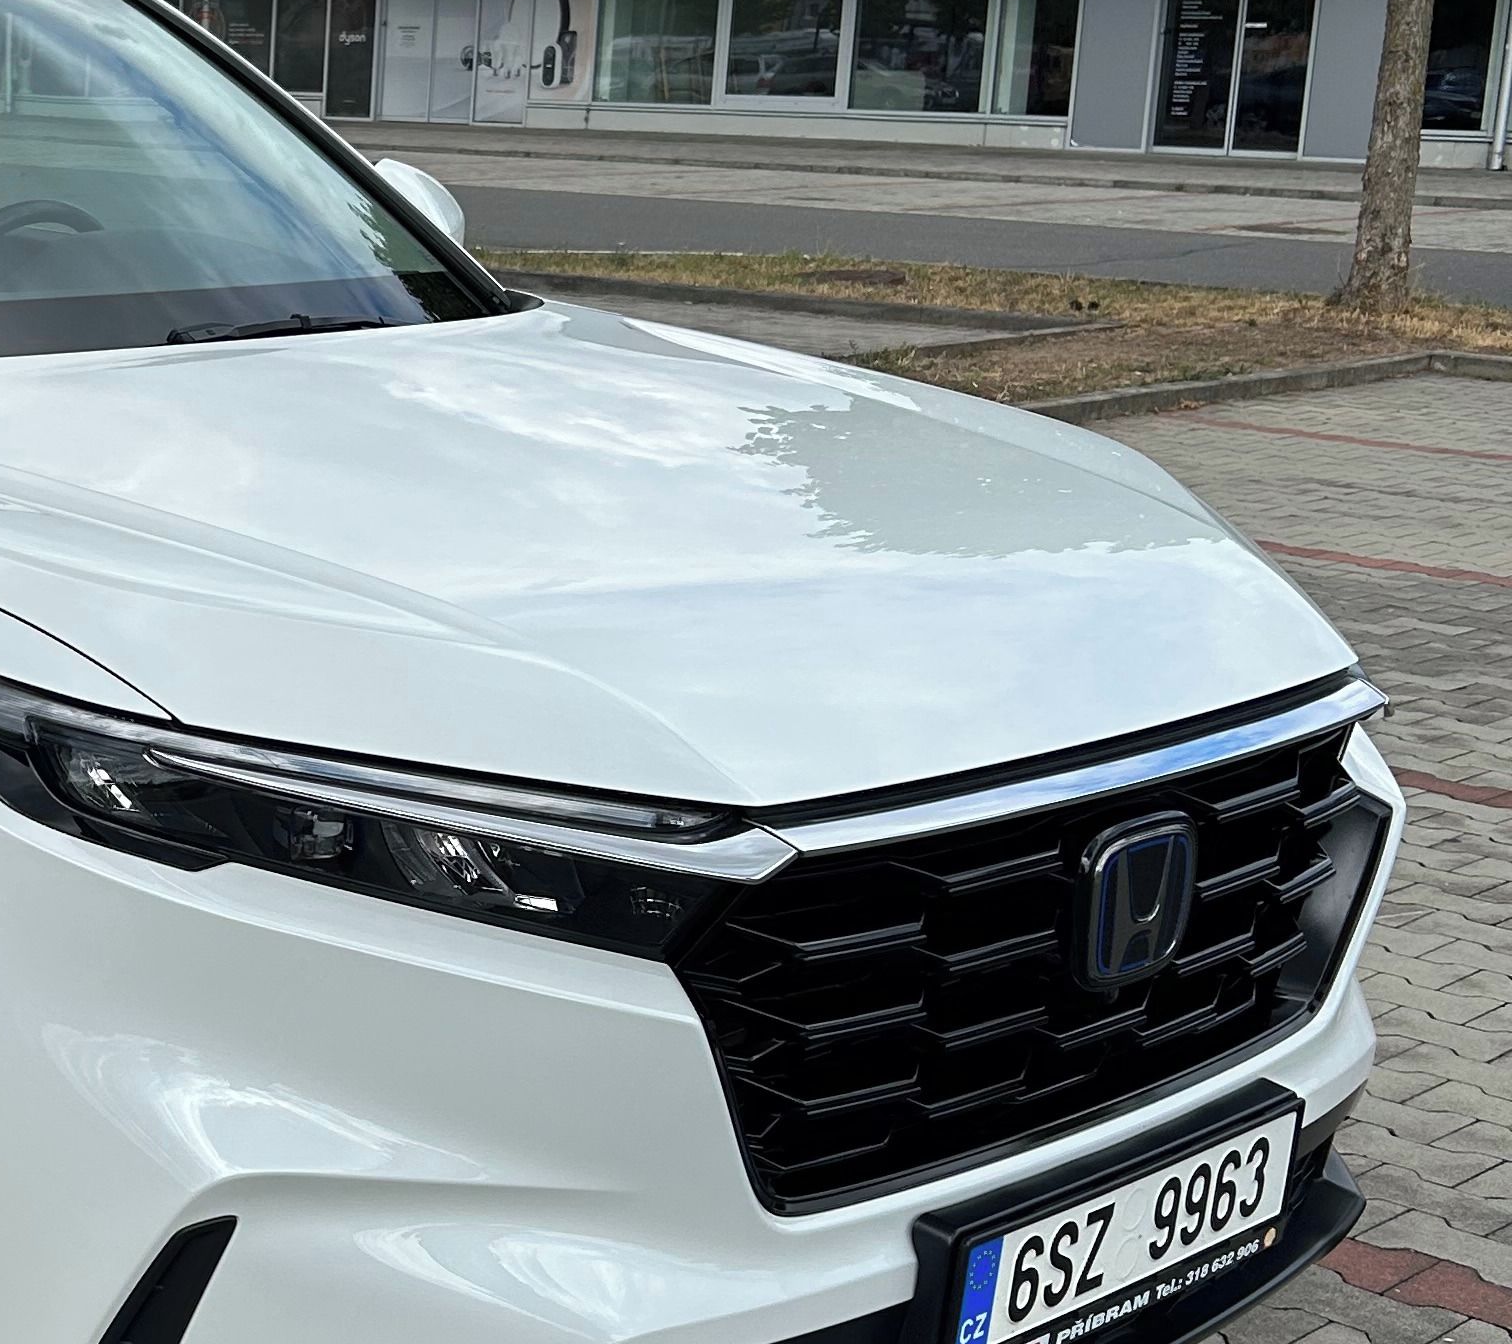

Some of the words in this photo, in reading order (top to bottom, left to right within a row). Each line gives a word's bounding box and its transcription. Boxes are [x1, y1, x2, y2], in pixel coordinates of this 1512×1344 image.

[339, 31, 366, 45] dyson
[1008, 1202, 1115, 1323] 6SZ
[1148, 1136, 1270, 1260] 9963
[1185, 1263, 1209, 1286] 318
[1211, 1251, 1235, 1273] 632
[1236, 1239, 1260, 1261] 906
[959, 1312, 987, 1344] CZ
